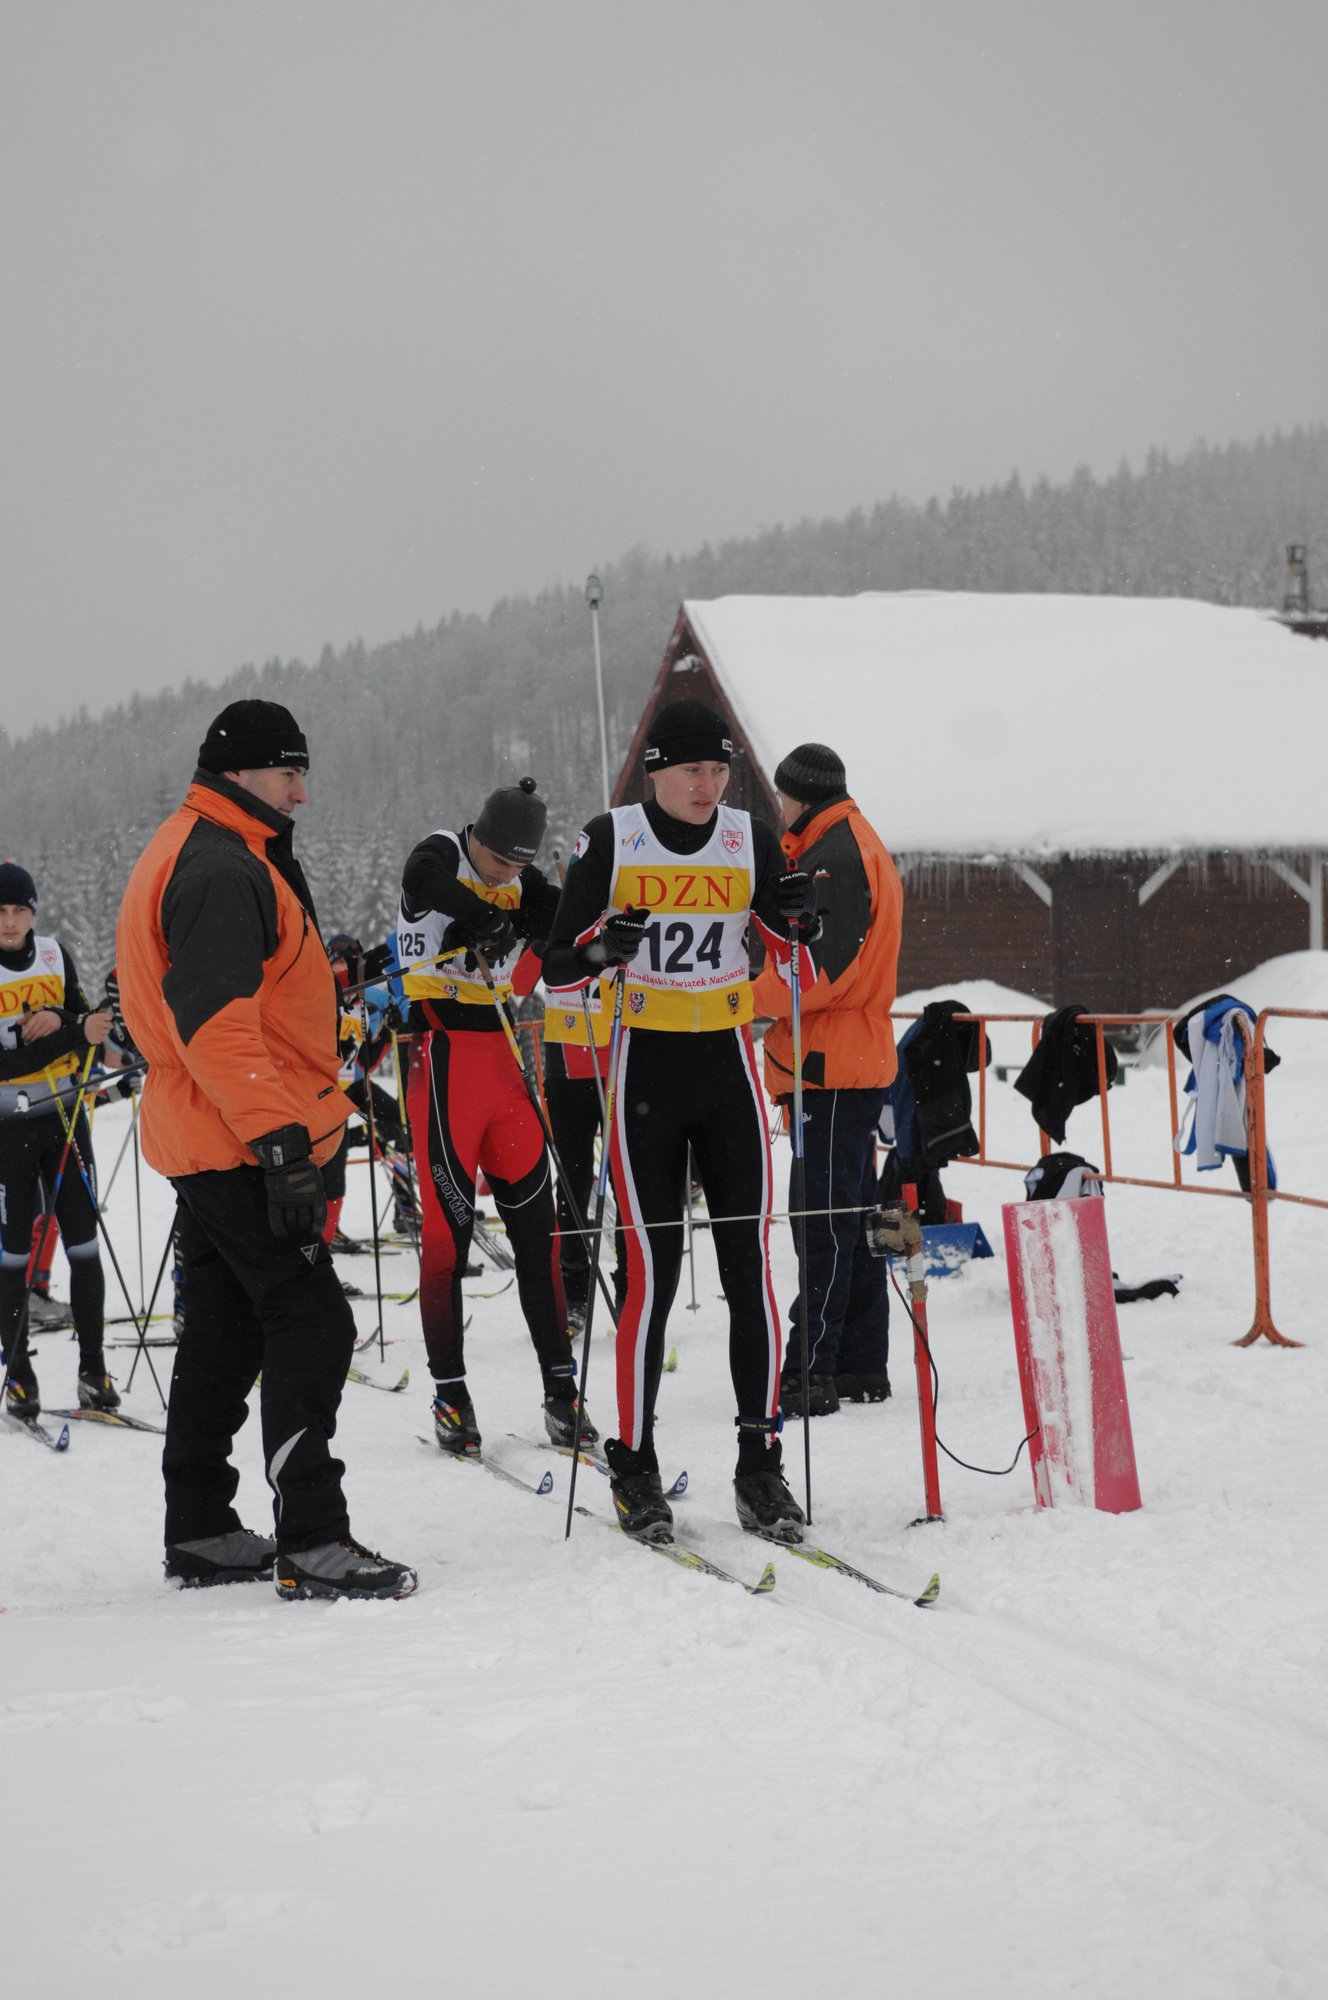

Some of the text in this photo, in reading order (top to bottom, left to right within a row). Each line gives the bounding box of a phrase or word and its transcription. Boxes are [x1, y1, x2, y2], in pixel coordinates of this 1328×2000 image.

[482, 889, 521, 909] ZN
[636, 875, 734, 908] DZN
[398, 932, 425, 957] 125
[641, 921, 725, 973] 124
[709, 965, 747, 985] Narciarsk
[432, 1164, 470, 1227] sportful
